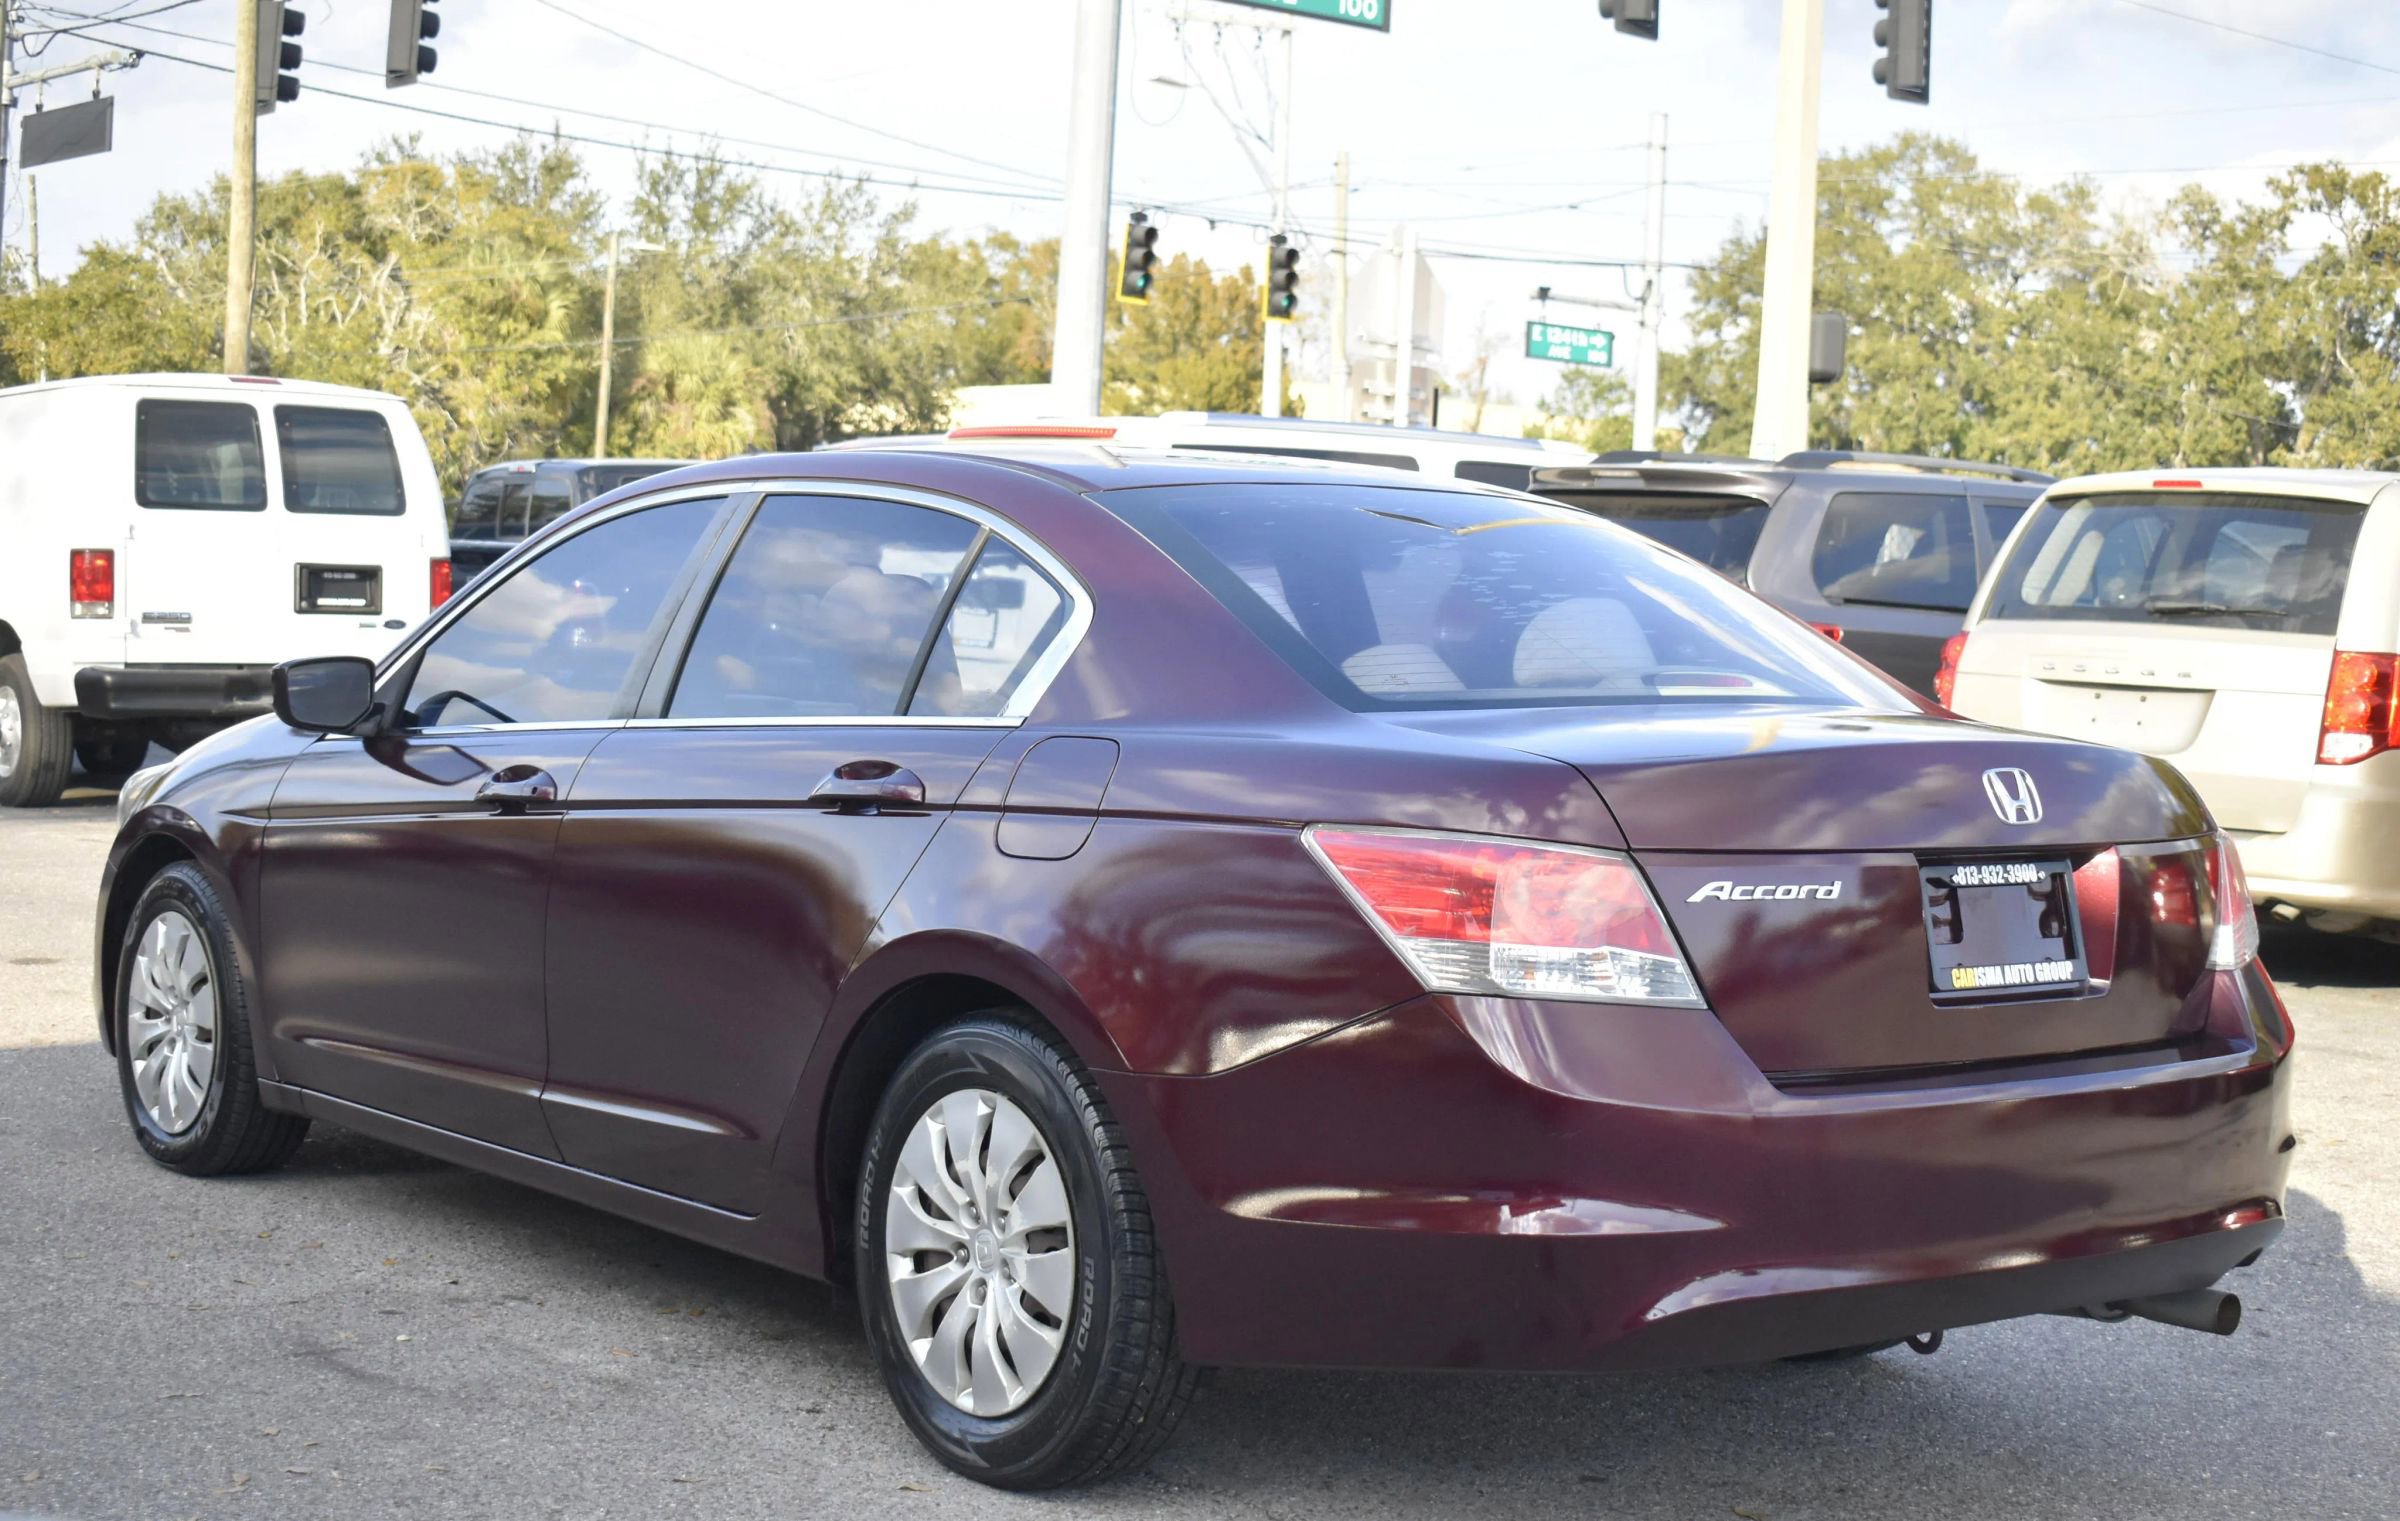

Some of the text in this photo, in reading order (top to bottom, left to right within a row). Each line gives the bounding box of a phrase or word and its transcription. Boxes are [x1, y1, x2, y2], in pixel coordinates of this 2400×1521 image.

[1531, 324, 1543, 342] E
[1957, 863, 2038, 886] 813-932-3900
[1685, 880, 1842, 903] Accord
[1951, 960, 2073, 989] CARISMA AUTO GROUP
[859, 1160, 876, 1249] ROAD
[1076, 1255, 1095, 1353] ROAD
